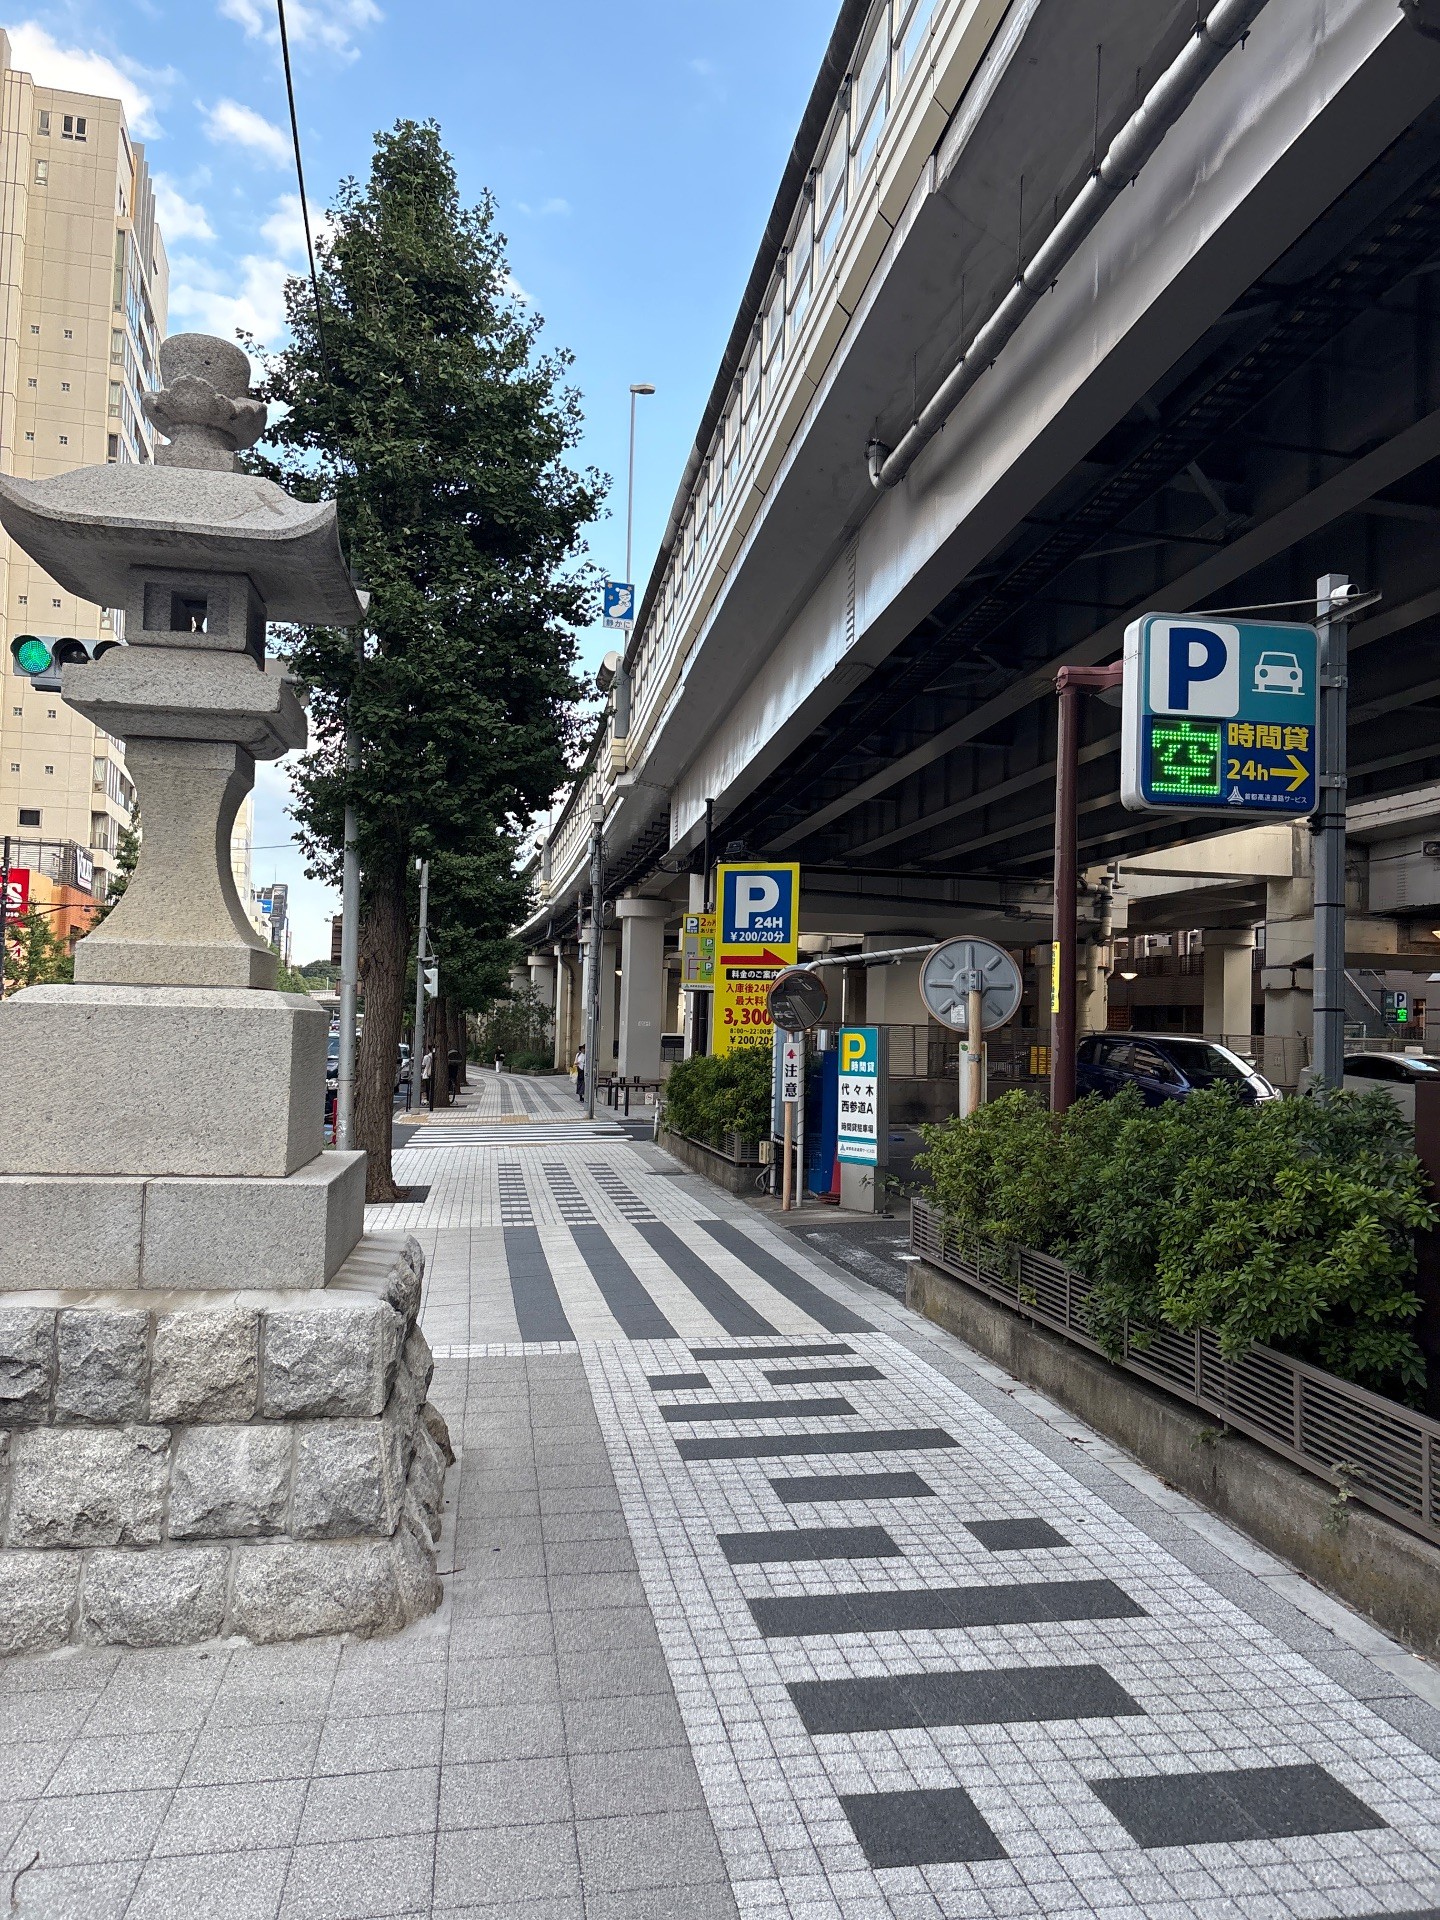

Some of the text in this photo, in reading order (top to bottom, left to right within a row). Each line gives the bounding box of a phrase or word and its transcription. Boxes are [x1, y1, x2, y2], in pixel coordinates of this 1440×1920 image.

[1168, 627, 1228, 711] P
[1227, 722, 1309, 752] 時間貸
[1151, 723, 1219, 795] 空
[1226, 758, 1270, 781] 24h
[735, 875, 780, 929] P
[754, 917, 783, 929] 24H
[735, 995, 767, 1006] 最大料
[1396, 992, 1405, 1008] P
[841, 1033, 866, 1072] P
[851, 1061, 875, 1073] 時間貸
[785, 1063, 798, 1098] 注意
[841, 1082, 874, 1097] 代々木
[841, 1101, 874, 1115] 西参道A
[840, 1122, 874, 1134] 時間貸駐車場
